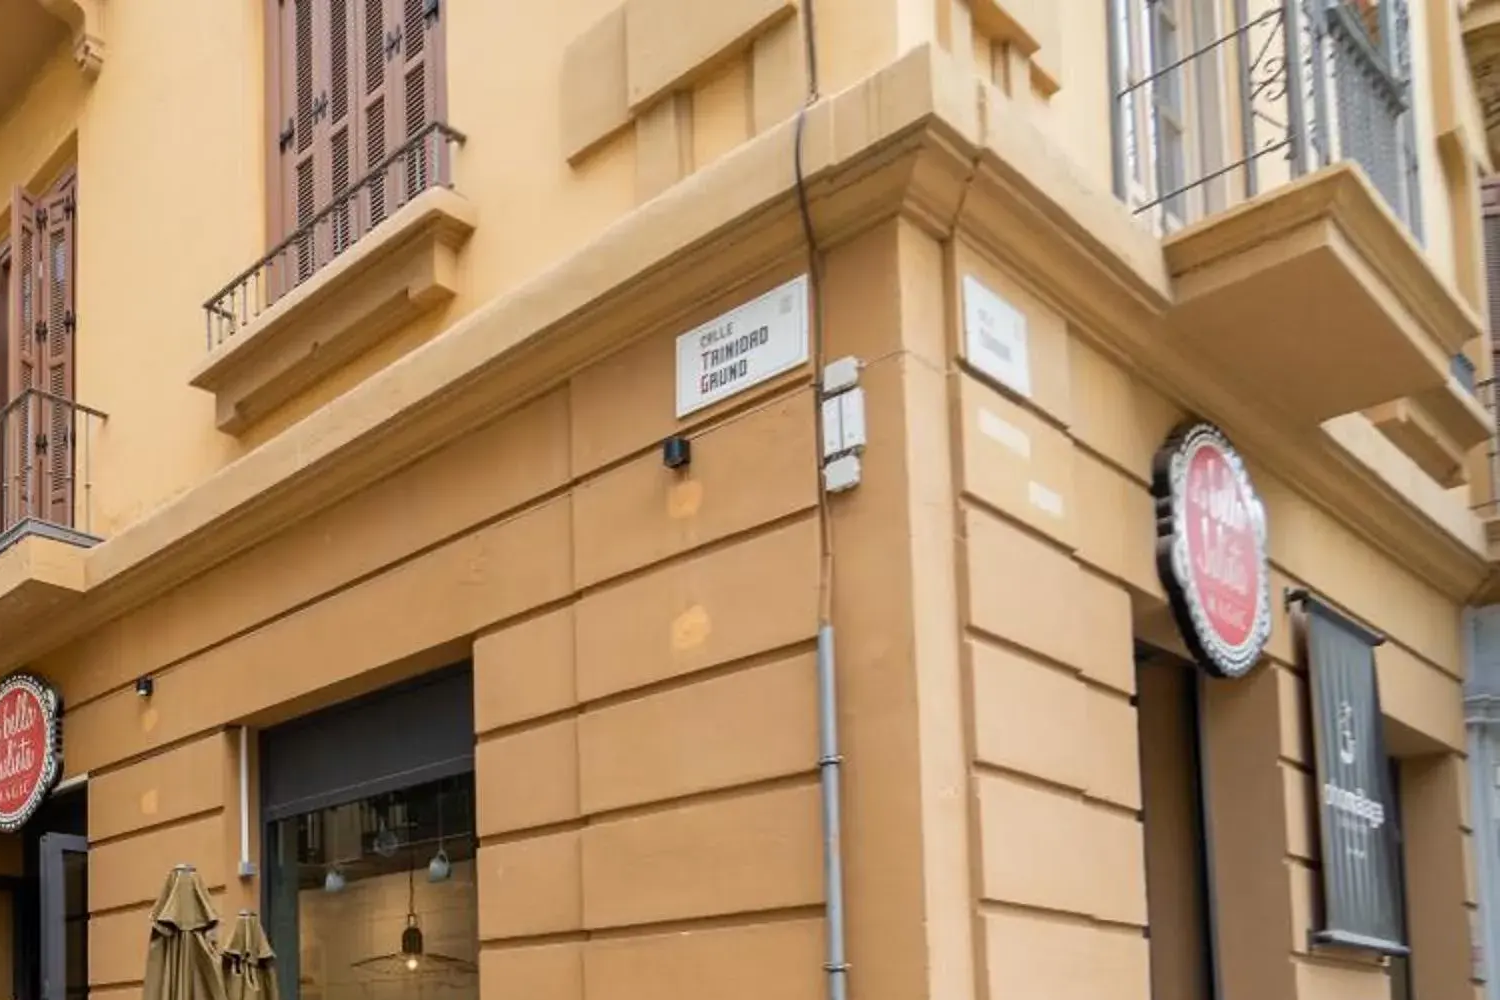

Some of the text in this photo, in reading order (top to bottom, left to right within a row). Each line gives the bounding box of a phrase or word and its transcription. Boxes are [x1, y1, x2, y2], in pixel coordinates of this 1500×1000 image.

[700, 321, 734, 349] CALLE
[700, 325, 769, 371] TRINIDAD
[700, 358, 748, 395] GRUND
